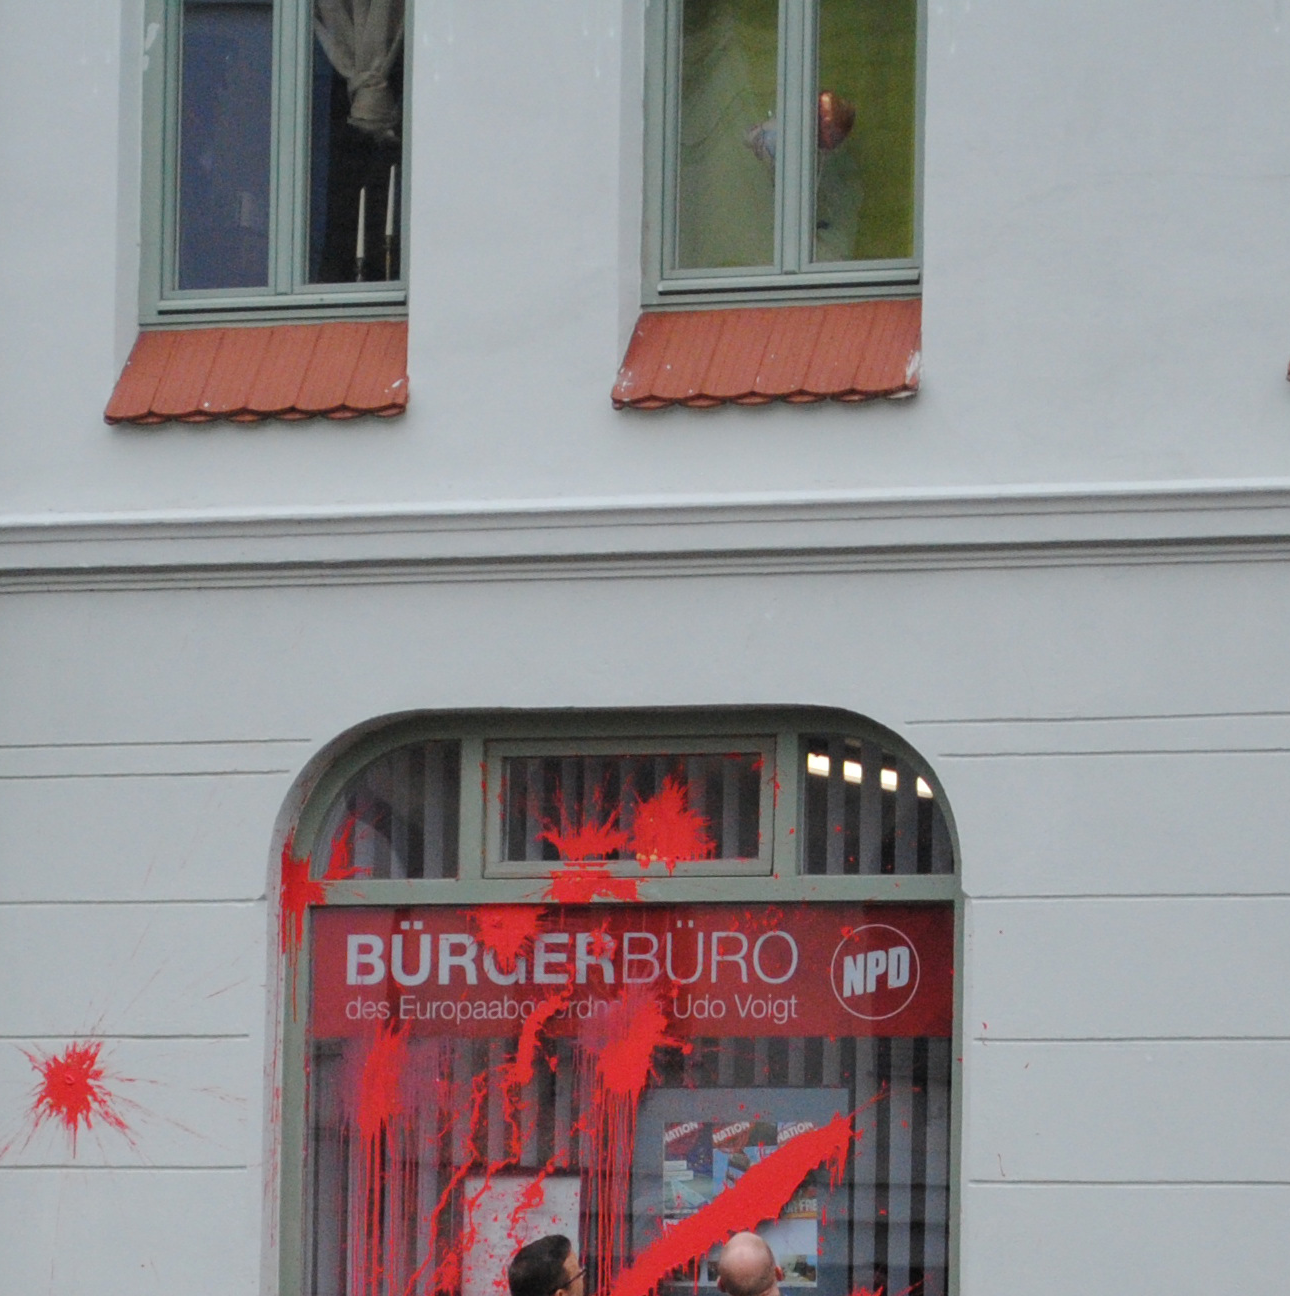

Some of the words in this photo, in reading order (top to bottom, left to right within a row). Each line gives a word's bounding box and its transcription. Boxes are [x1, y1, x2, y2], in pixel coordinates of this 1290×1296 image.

[842, 946, 909, 998] NPD
[345, 995, 391, 1020] des
[673, 994, 726, 1019] Udo
[735, 994, 798, 1024] Voigt
[712, 1121, 750, 1143] NATION
